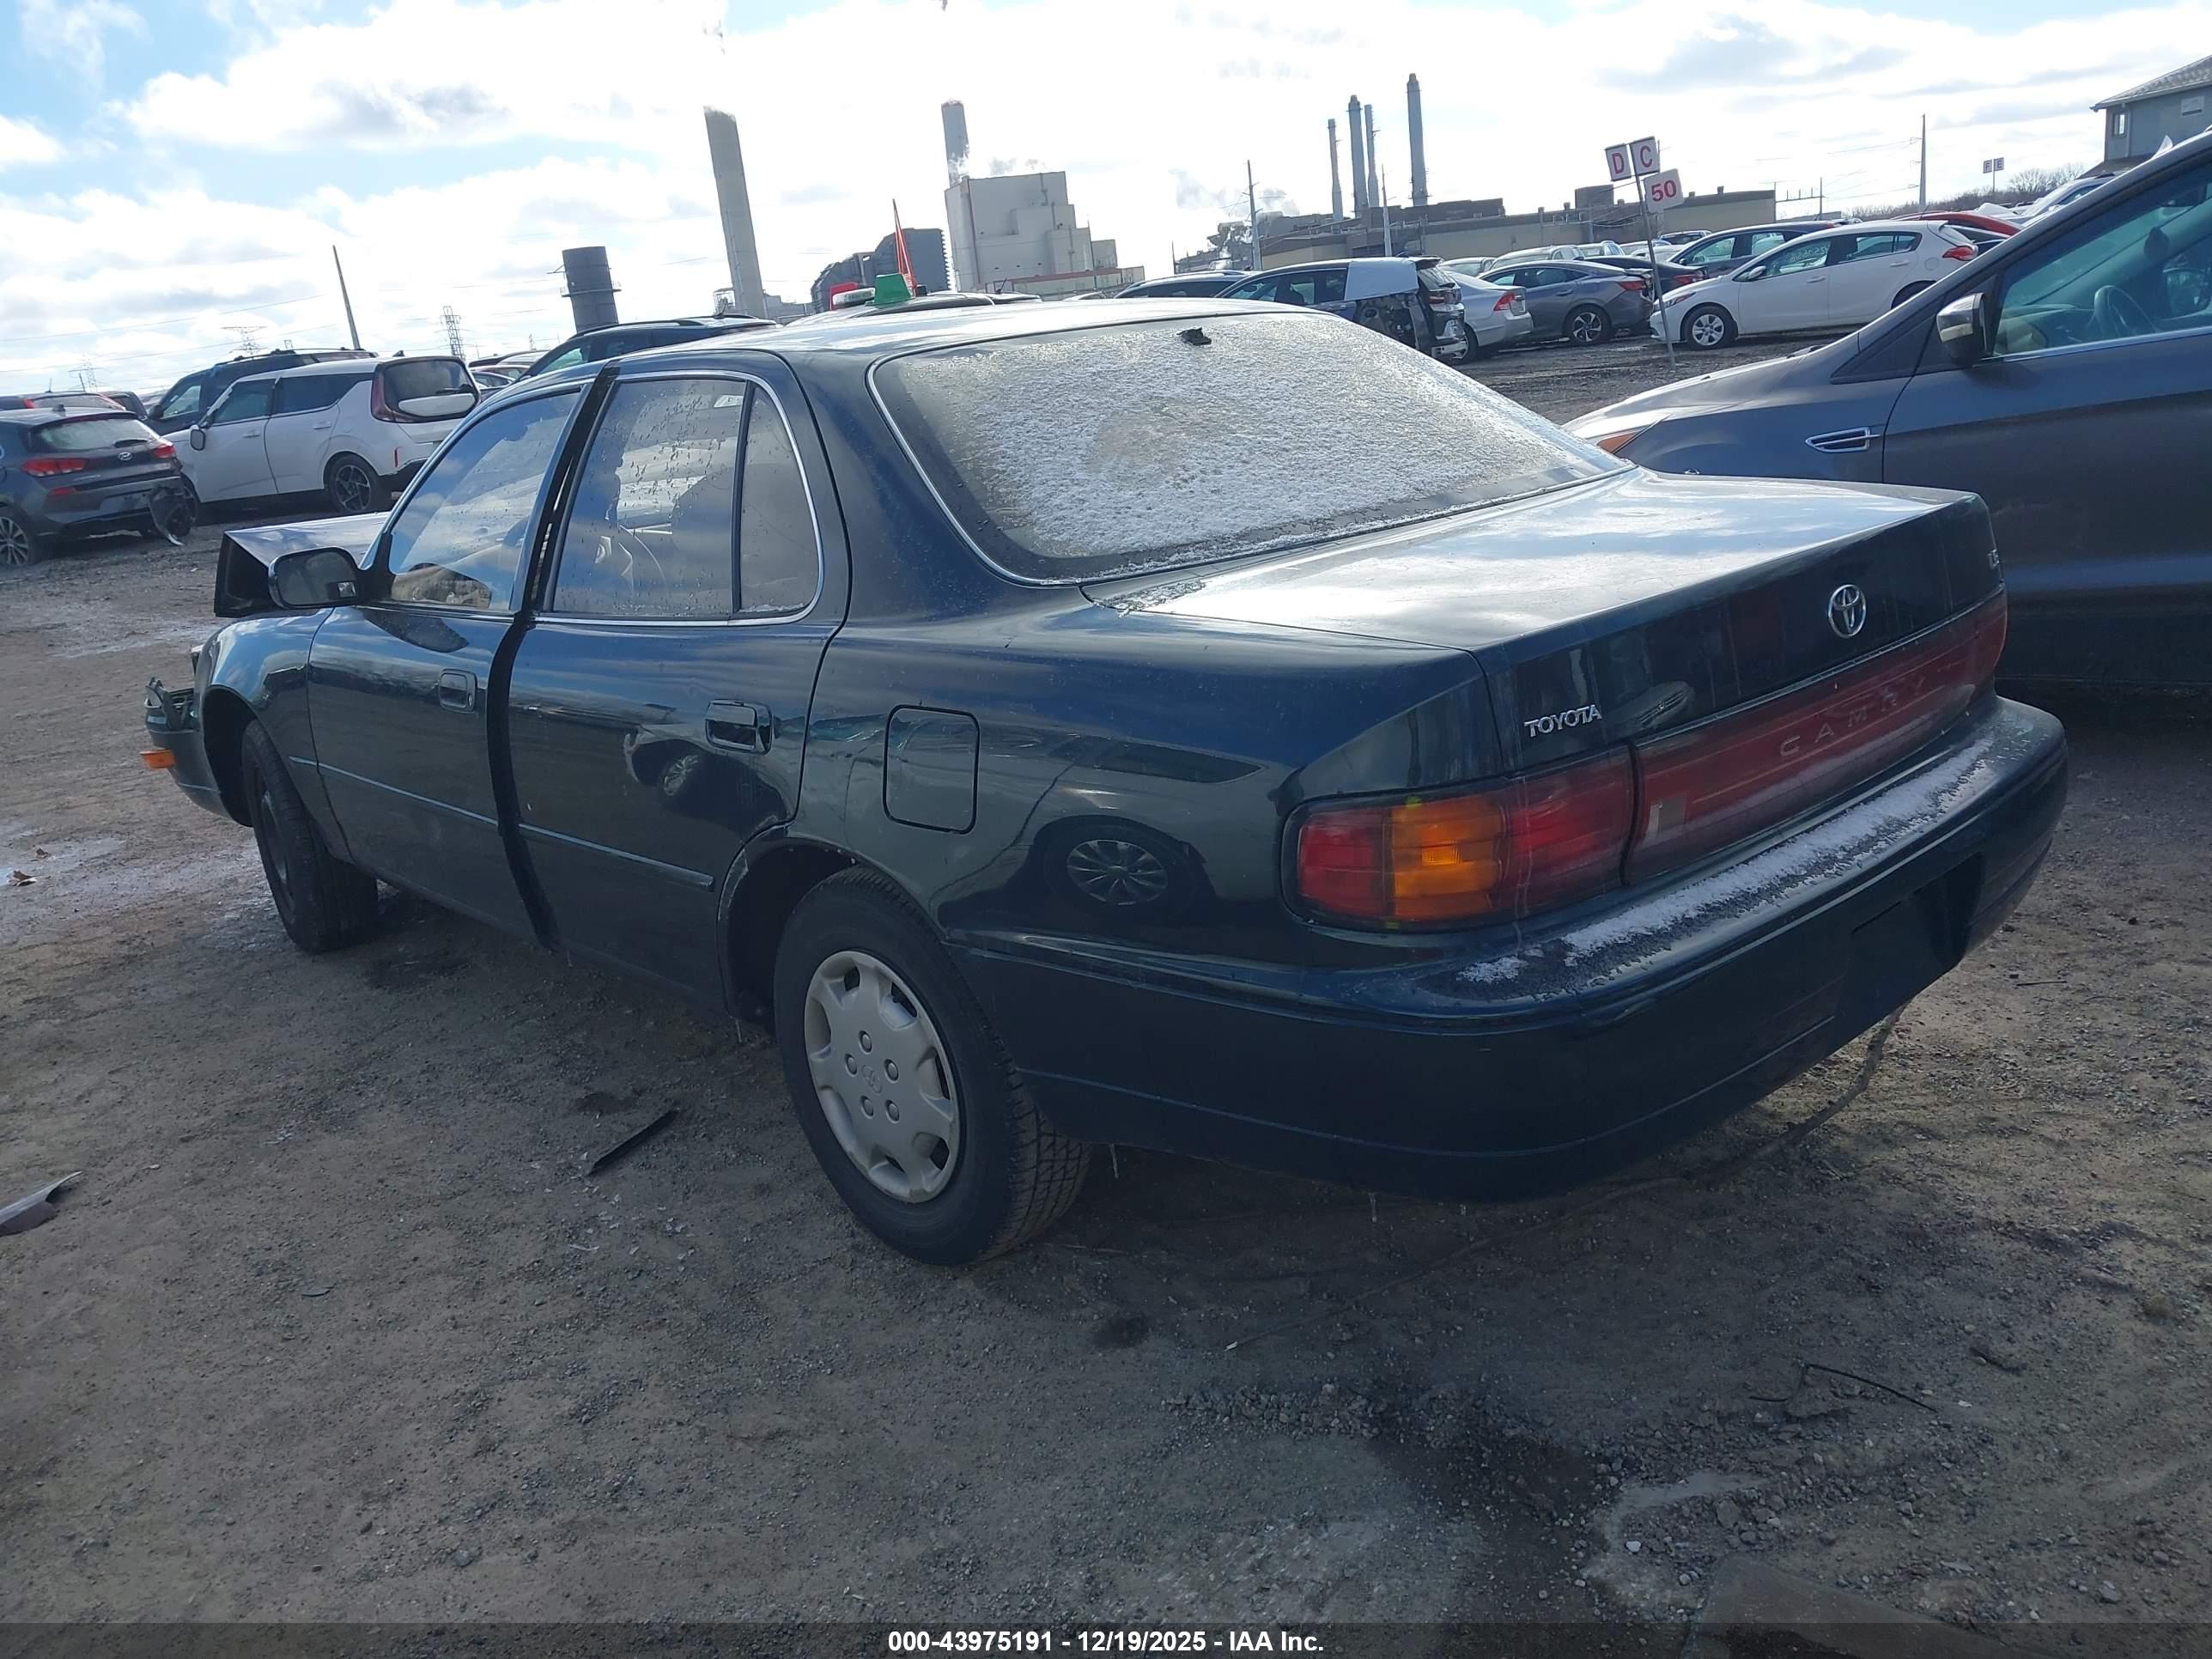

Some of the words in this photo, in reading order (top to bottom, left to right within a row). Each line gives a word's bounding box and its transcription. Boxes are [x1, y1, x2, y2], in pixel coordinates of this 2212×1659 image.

[1612, 152, 1625, 174] D
[1639, 145, 1653, 167] C
[1650, 179, 1677, 202] 50
[1523, 704, 1602, 738] TOYOTA
